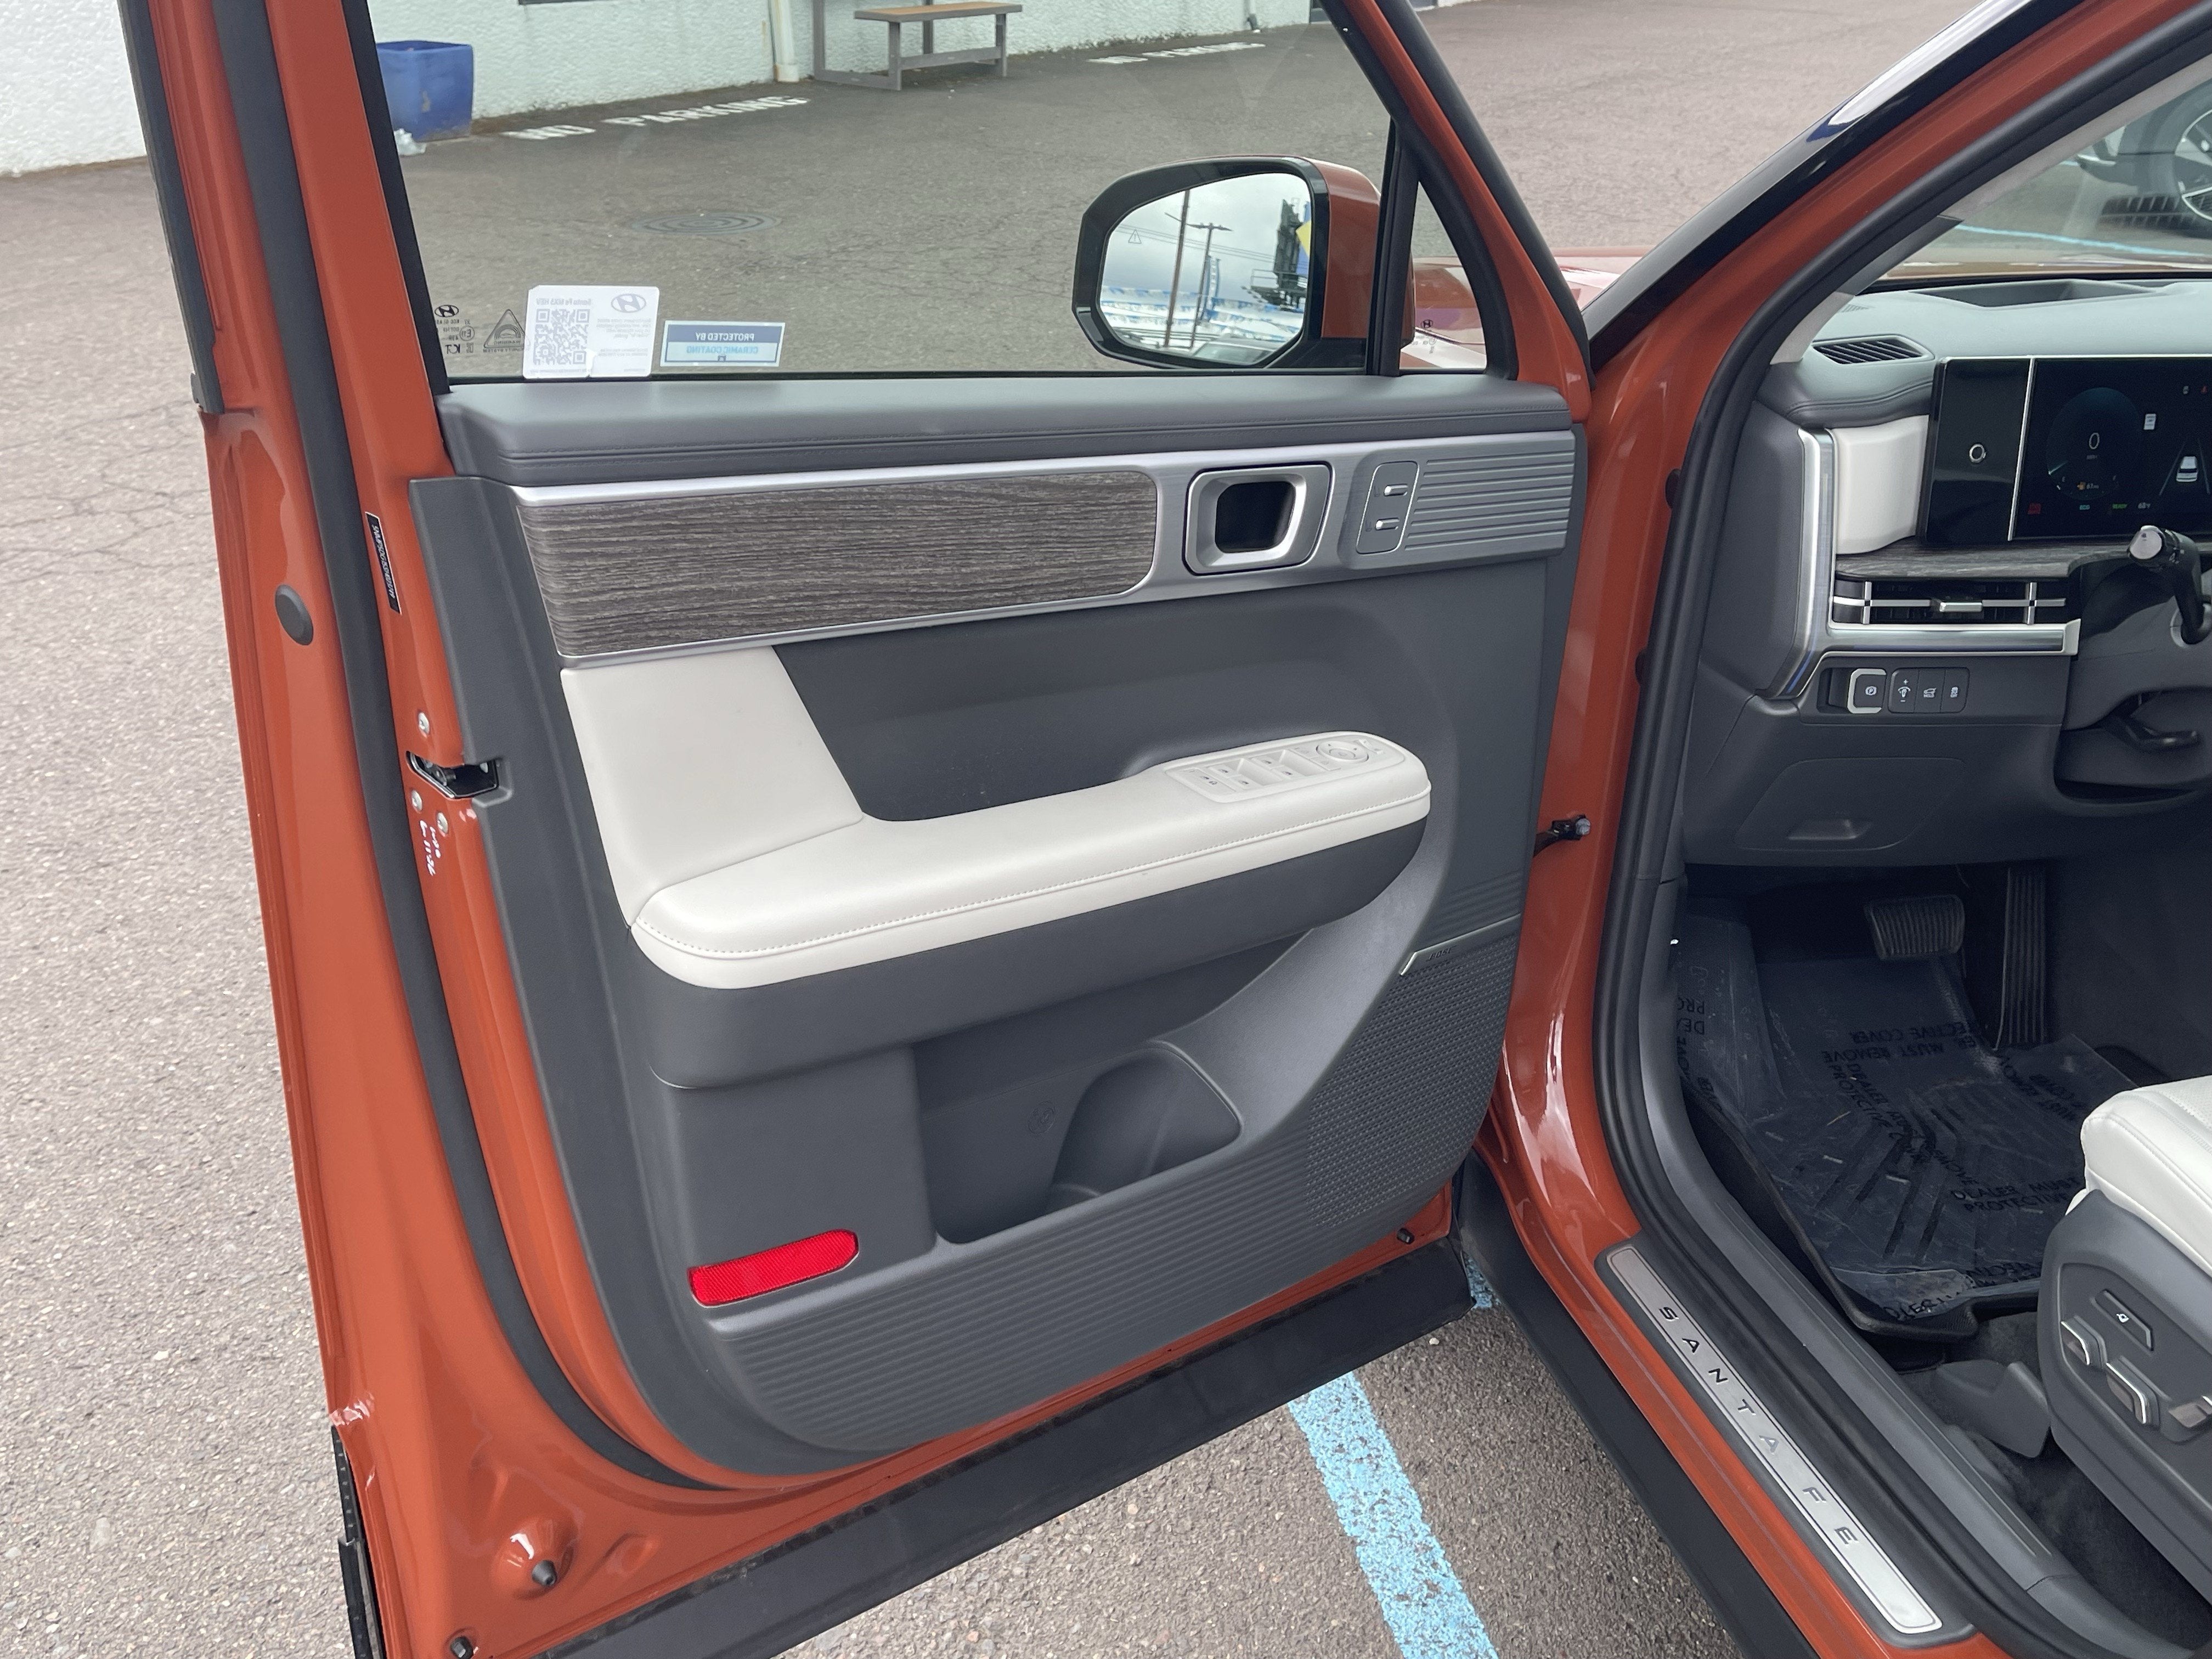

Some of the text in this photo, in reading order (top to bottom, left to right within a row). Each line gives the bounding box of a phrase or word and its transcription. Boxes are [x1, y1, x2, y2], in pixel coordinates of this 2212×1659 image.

[600, 95, 811, 127] PARKING
[1659, 1306, 1859, 1545] SANTA FE
